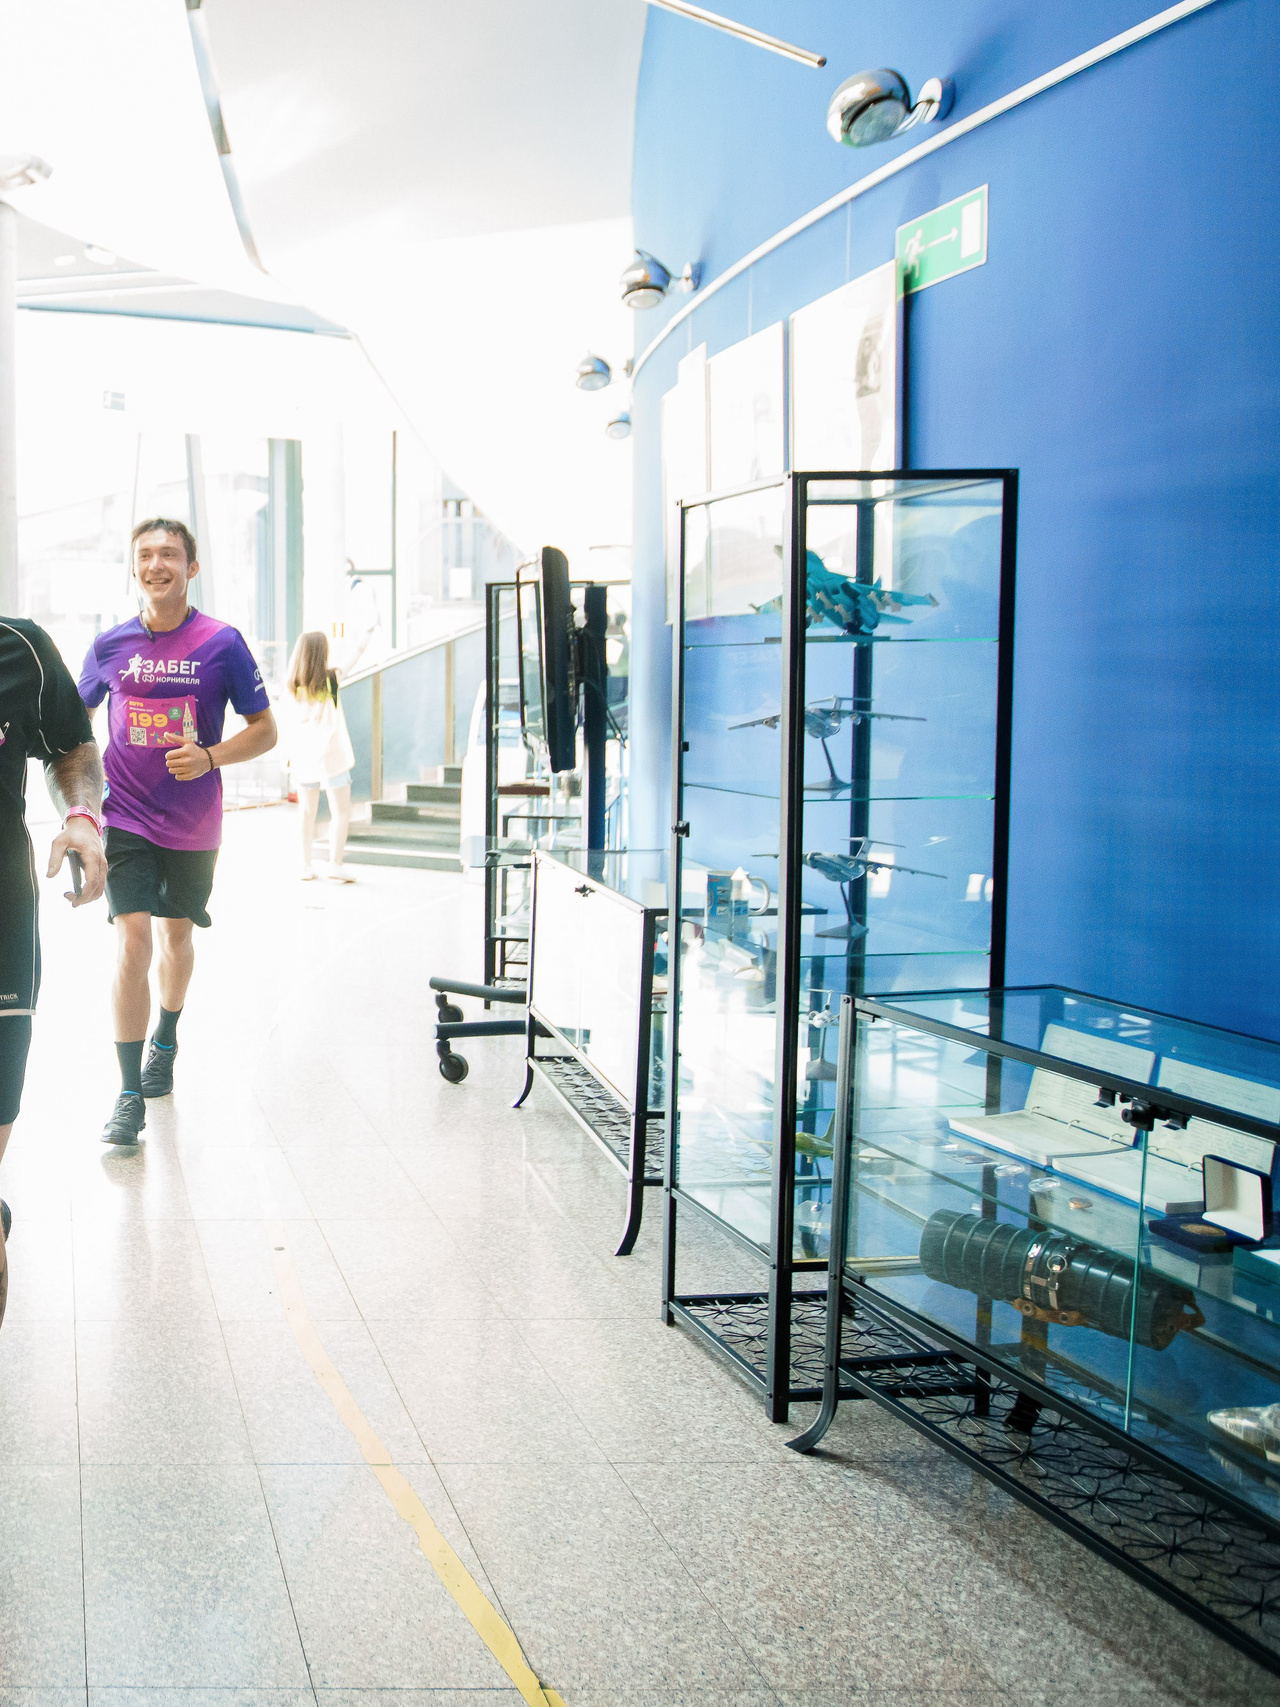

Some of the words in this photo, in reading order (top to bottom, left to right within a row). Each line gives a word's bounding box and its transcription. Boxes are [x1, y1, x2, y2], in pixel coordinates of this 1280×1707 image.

[142, 659, 201, 675] ЗАБЕГ
[156, 676, 200, 685] НОРНИКЕЛЯ
[129, 711, 168, 728] 199
